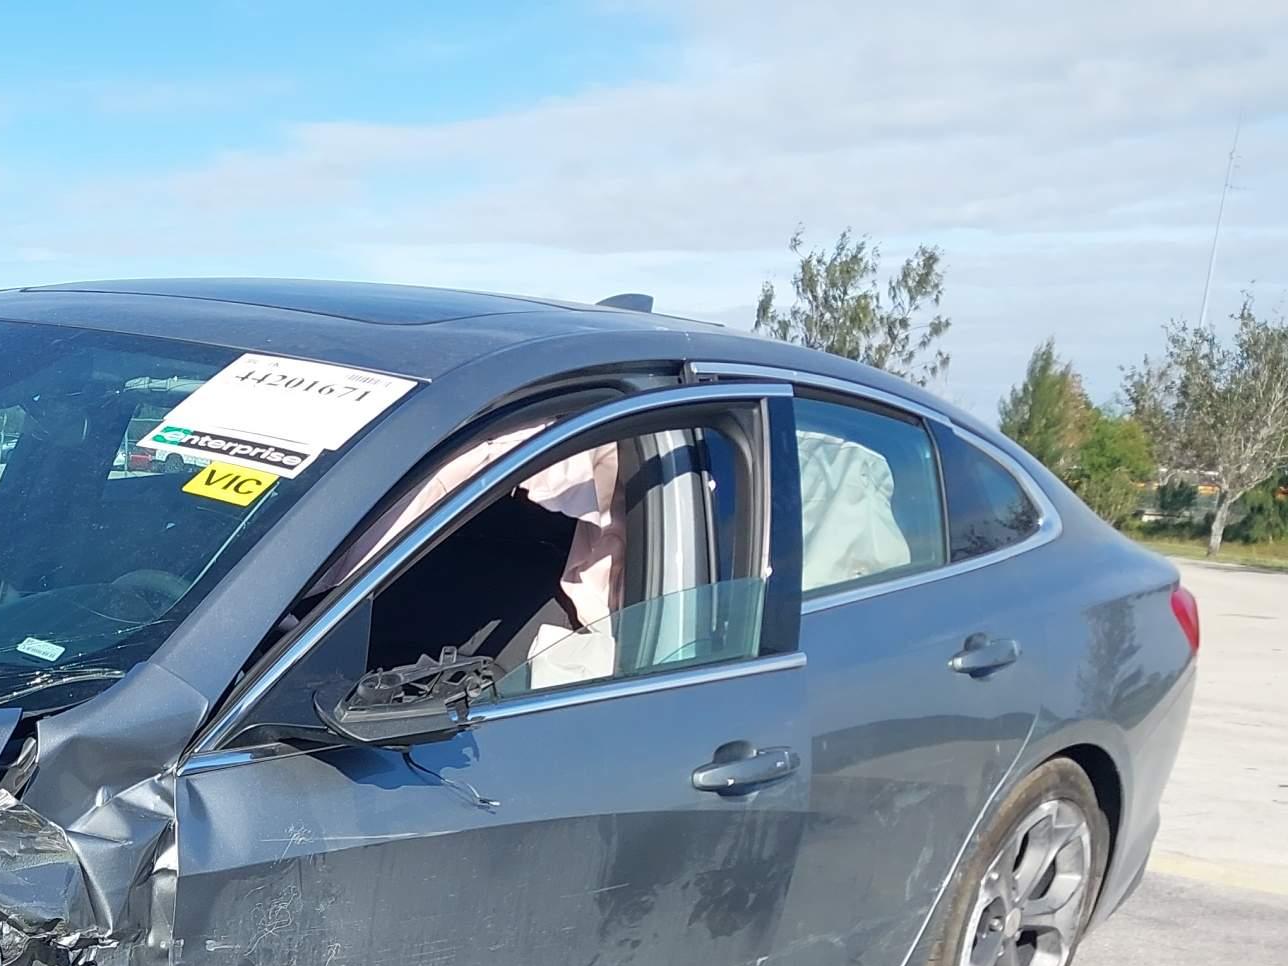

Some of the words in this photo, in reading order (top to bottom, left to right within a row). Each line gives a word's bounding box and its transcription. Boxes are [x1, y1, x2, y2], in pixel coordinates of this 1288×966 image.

[234, 369, 372, 402] 44201671
[160, 429, 304, 467] enterprise
[204, 468, 263, 496] VIC
